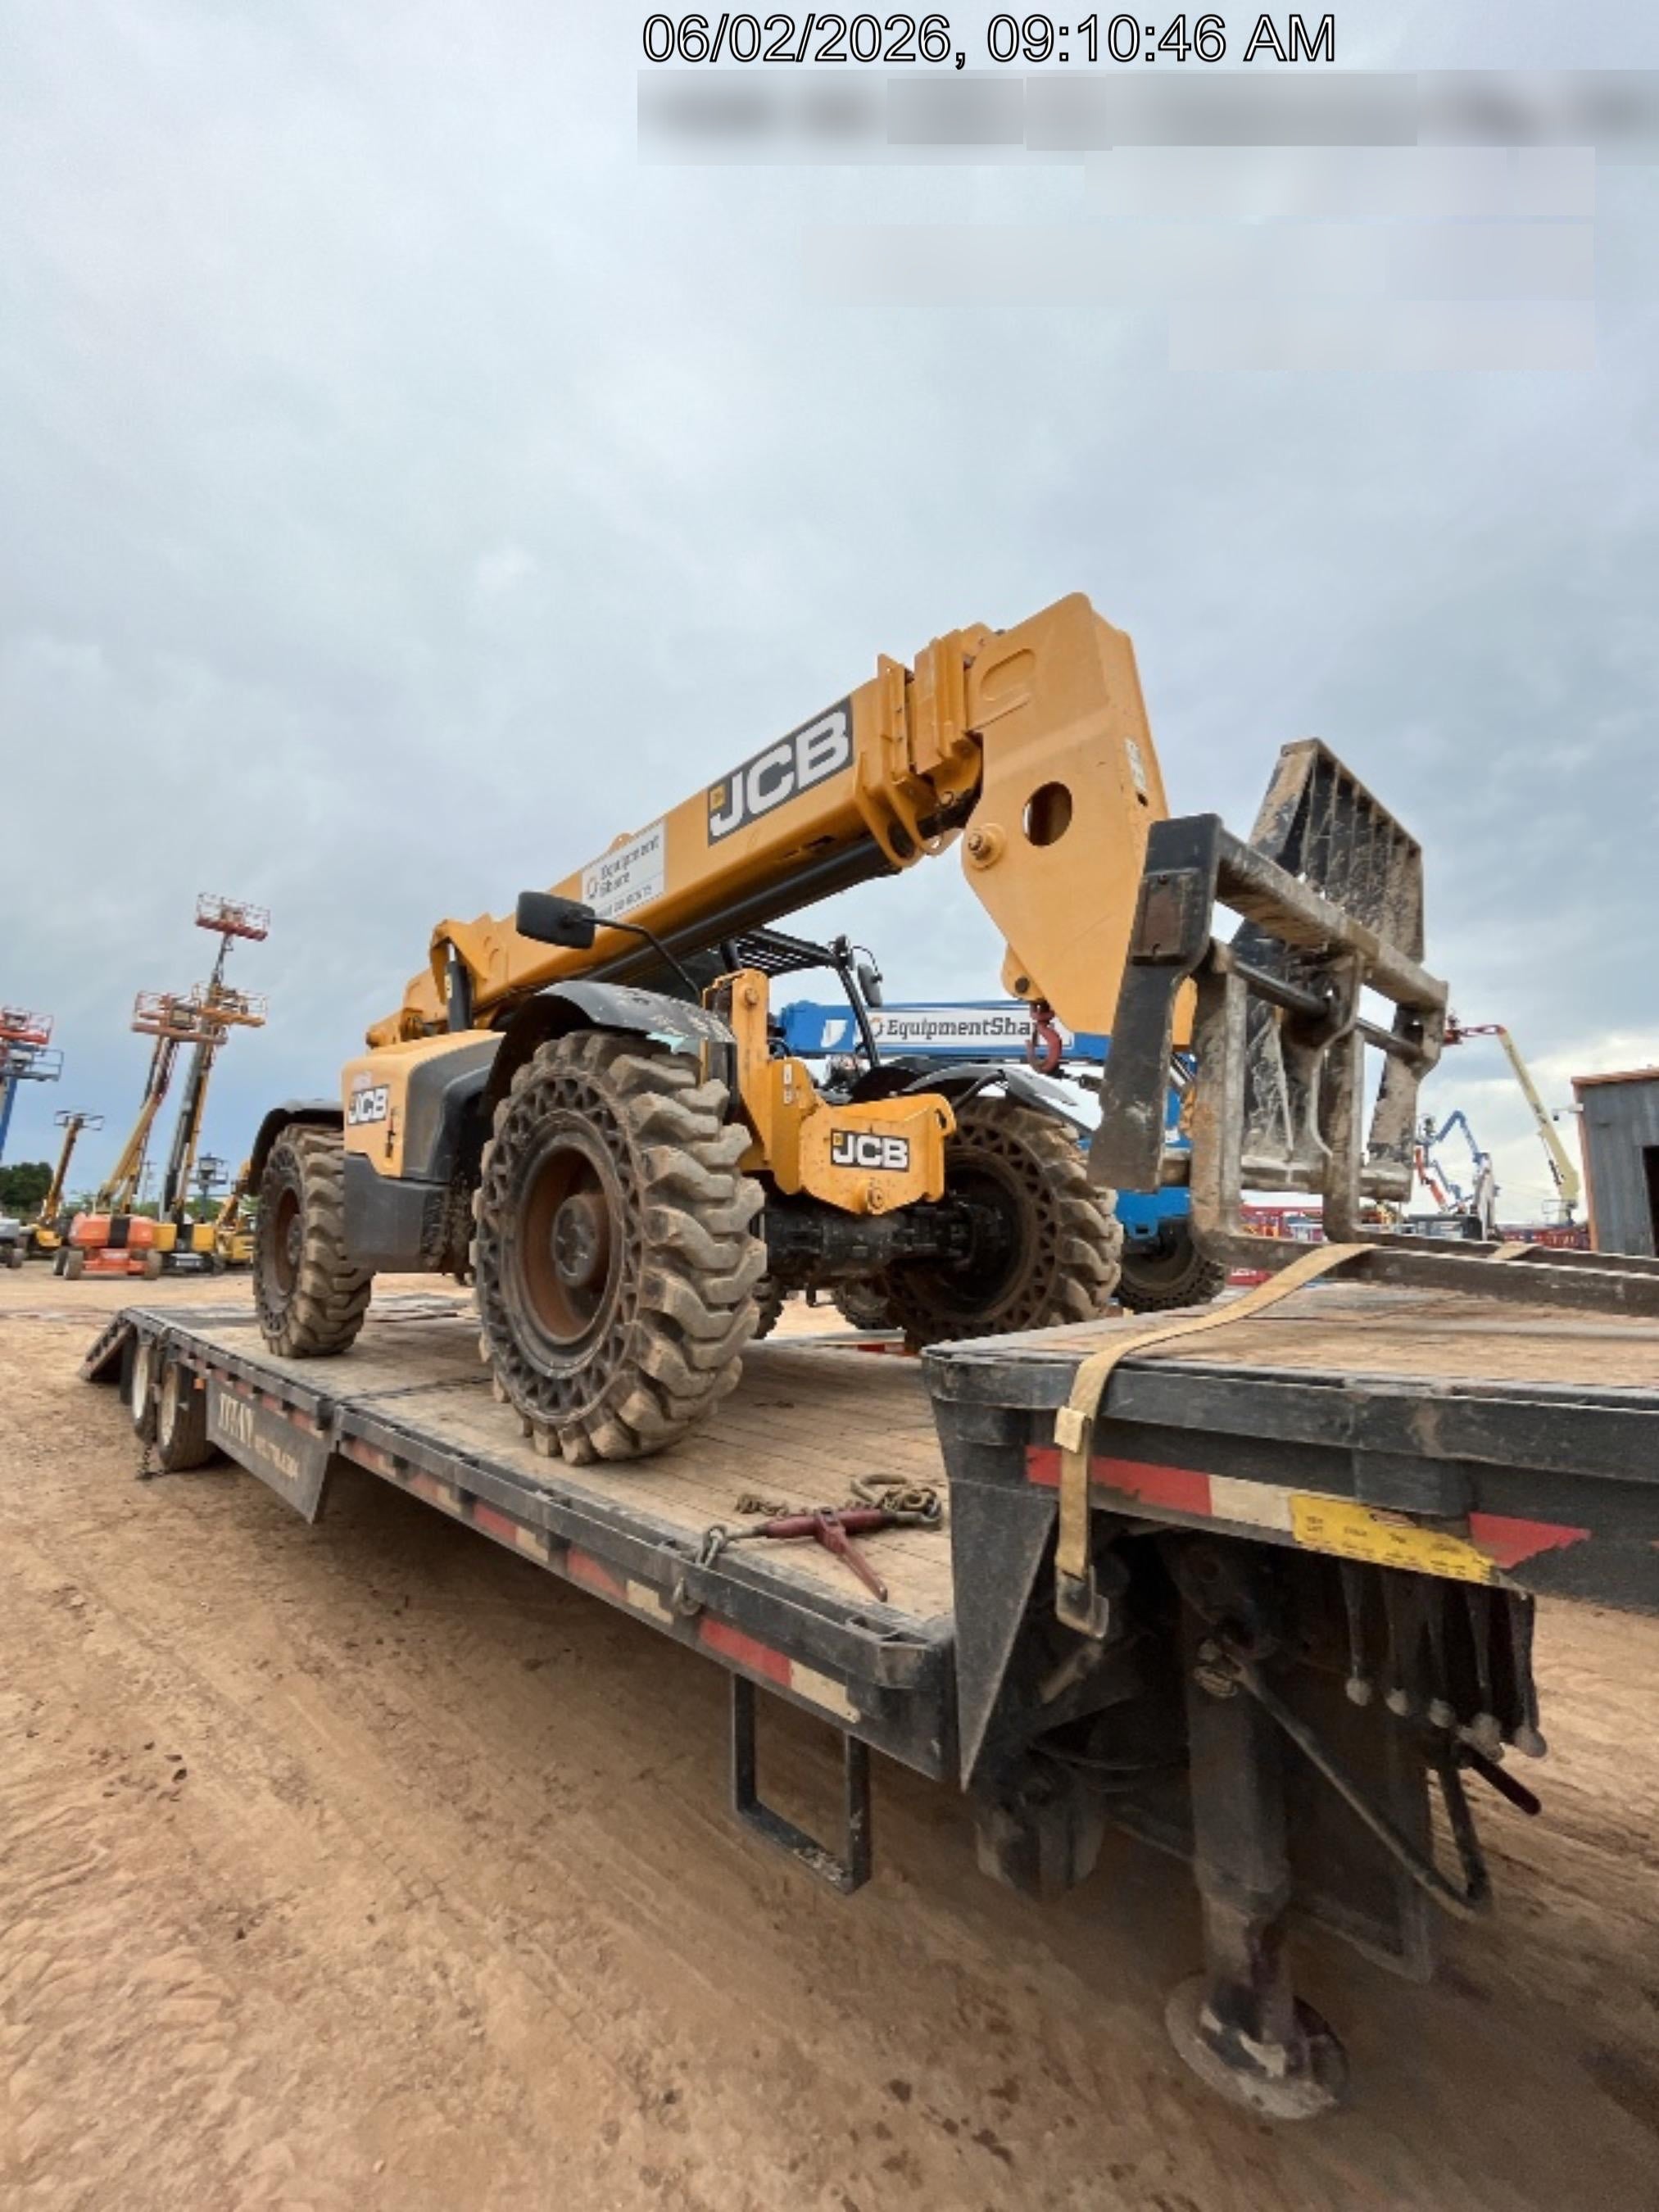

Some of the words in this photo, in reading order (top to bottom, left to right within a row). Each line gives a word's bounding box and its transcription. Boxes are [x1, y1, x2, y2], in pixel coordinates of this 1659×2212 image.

[709, 710, 850, 837] JCB
[886, 1016, 1054, 1040] EquipmentSha
[348, 1087, 388, 1125] JCB
[832, 1134, 909, 1170] JCB
